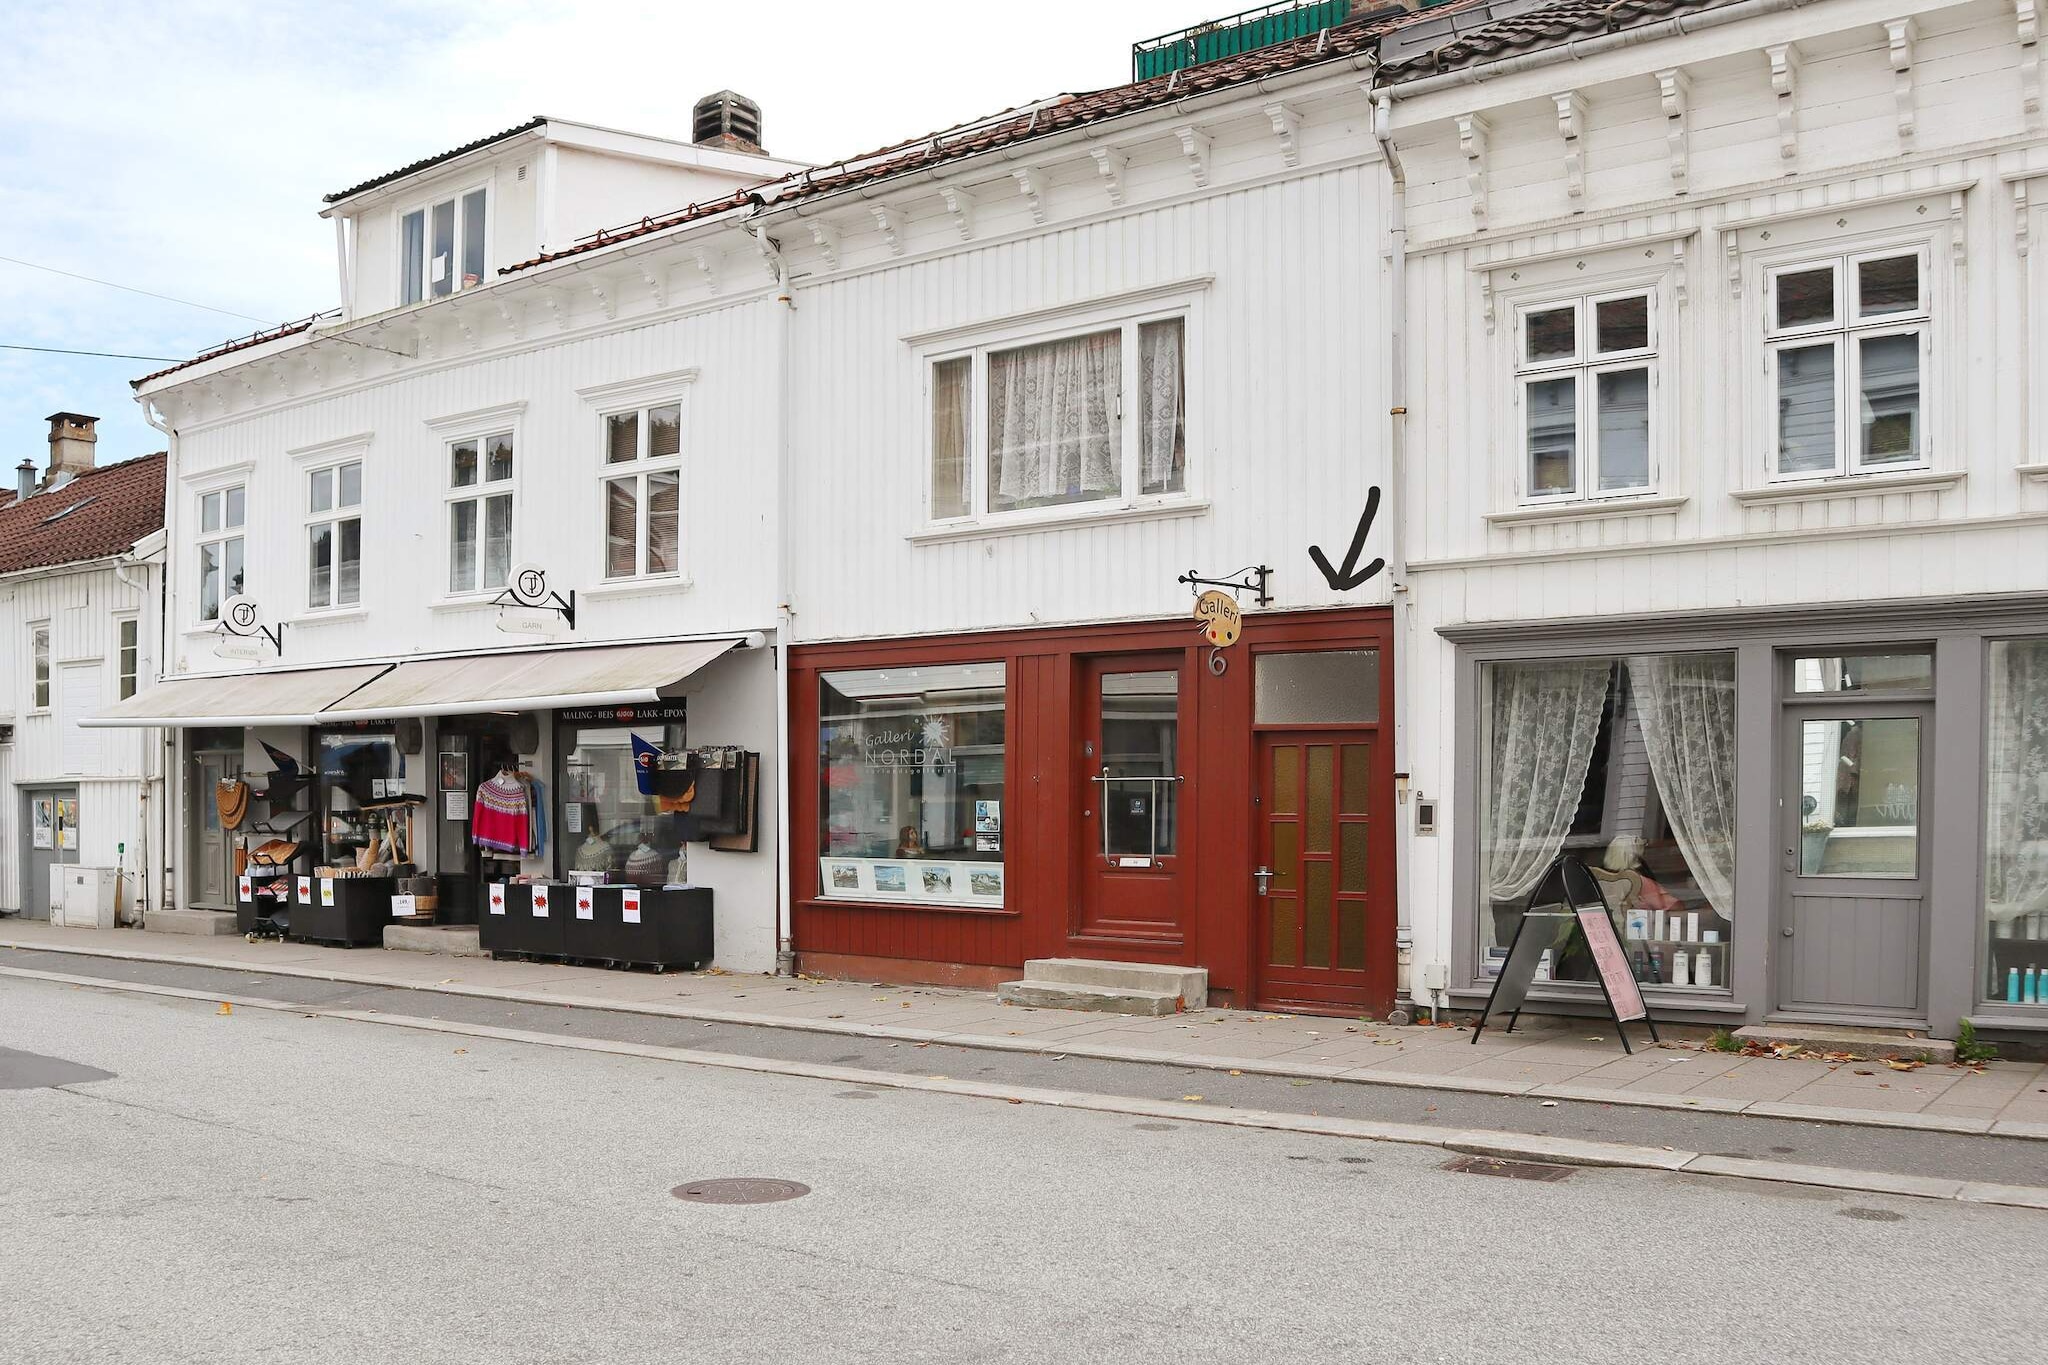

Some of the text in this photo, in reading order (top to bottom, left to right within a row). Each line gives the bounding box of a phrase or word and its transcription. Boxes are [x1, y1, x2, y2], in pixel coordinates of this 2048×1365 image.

[1200, 598, 1239, 625] Galleri
[1209, 647, 1227, 675] 6
[562, 711, 593, 720] MALING
[598, 710, 614, 719] BEIS
[637, 709, 659, 718] LAKK
[865, 729, 914, 747] Galleri
[865, 748, 956, 765] NORDAL
